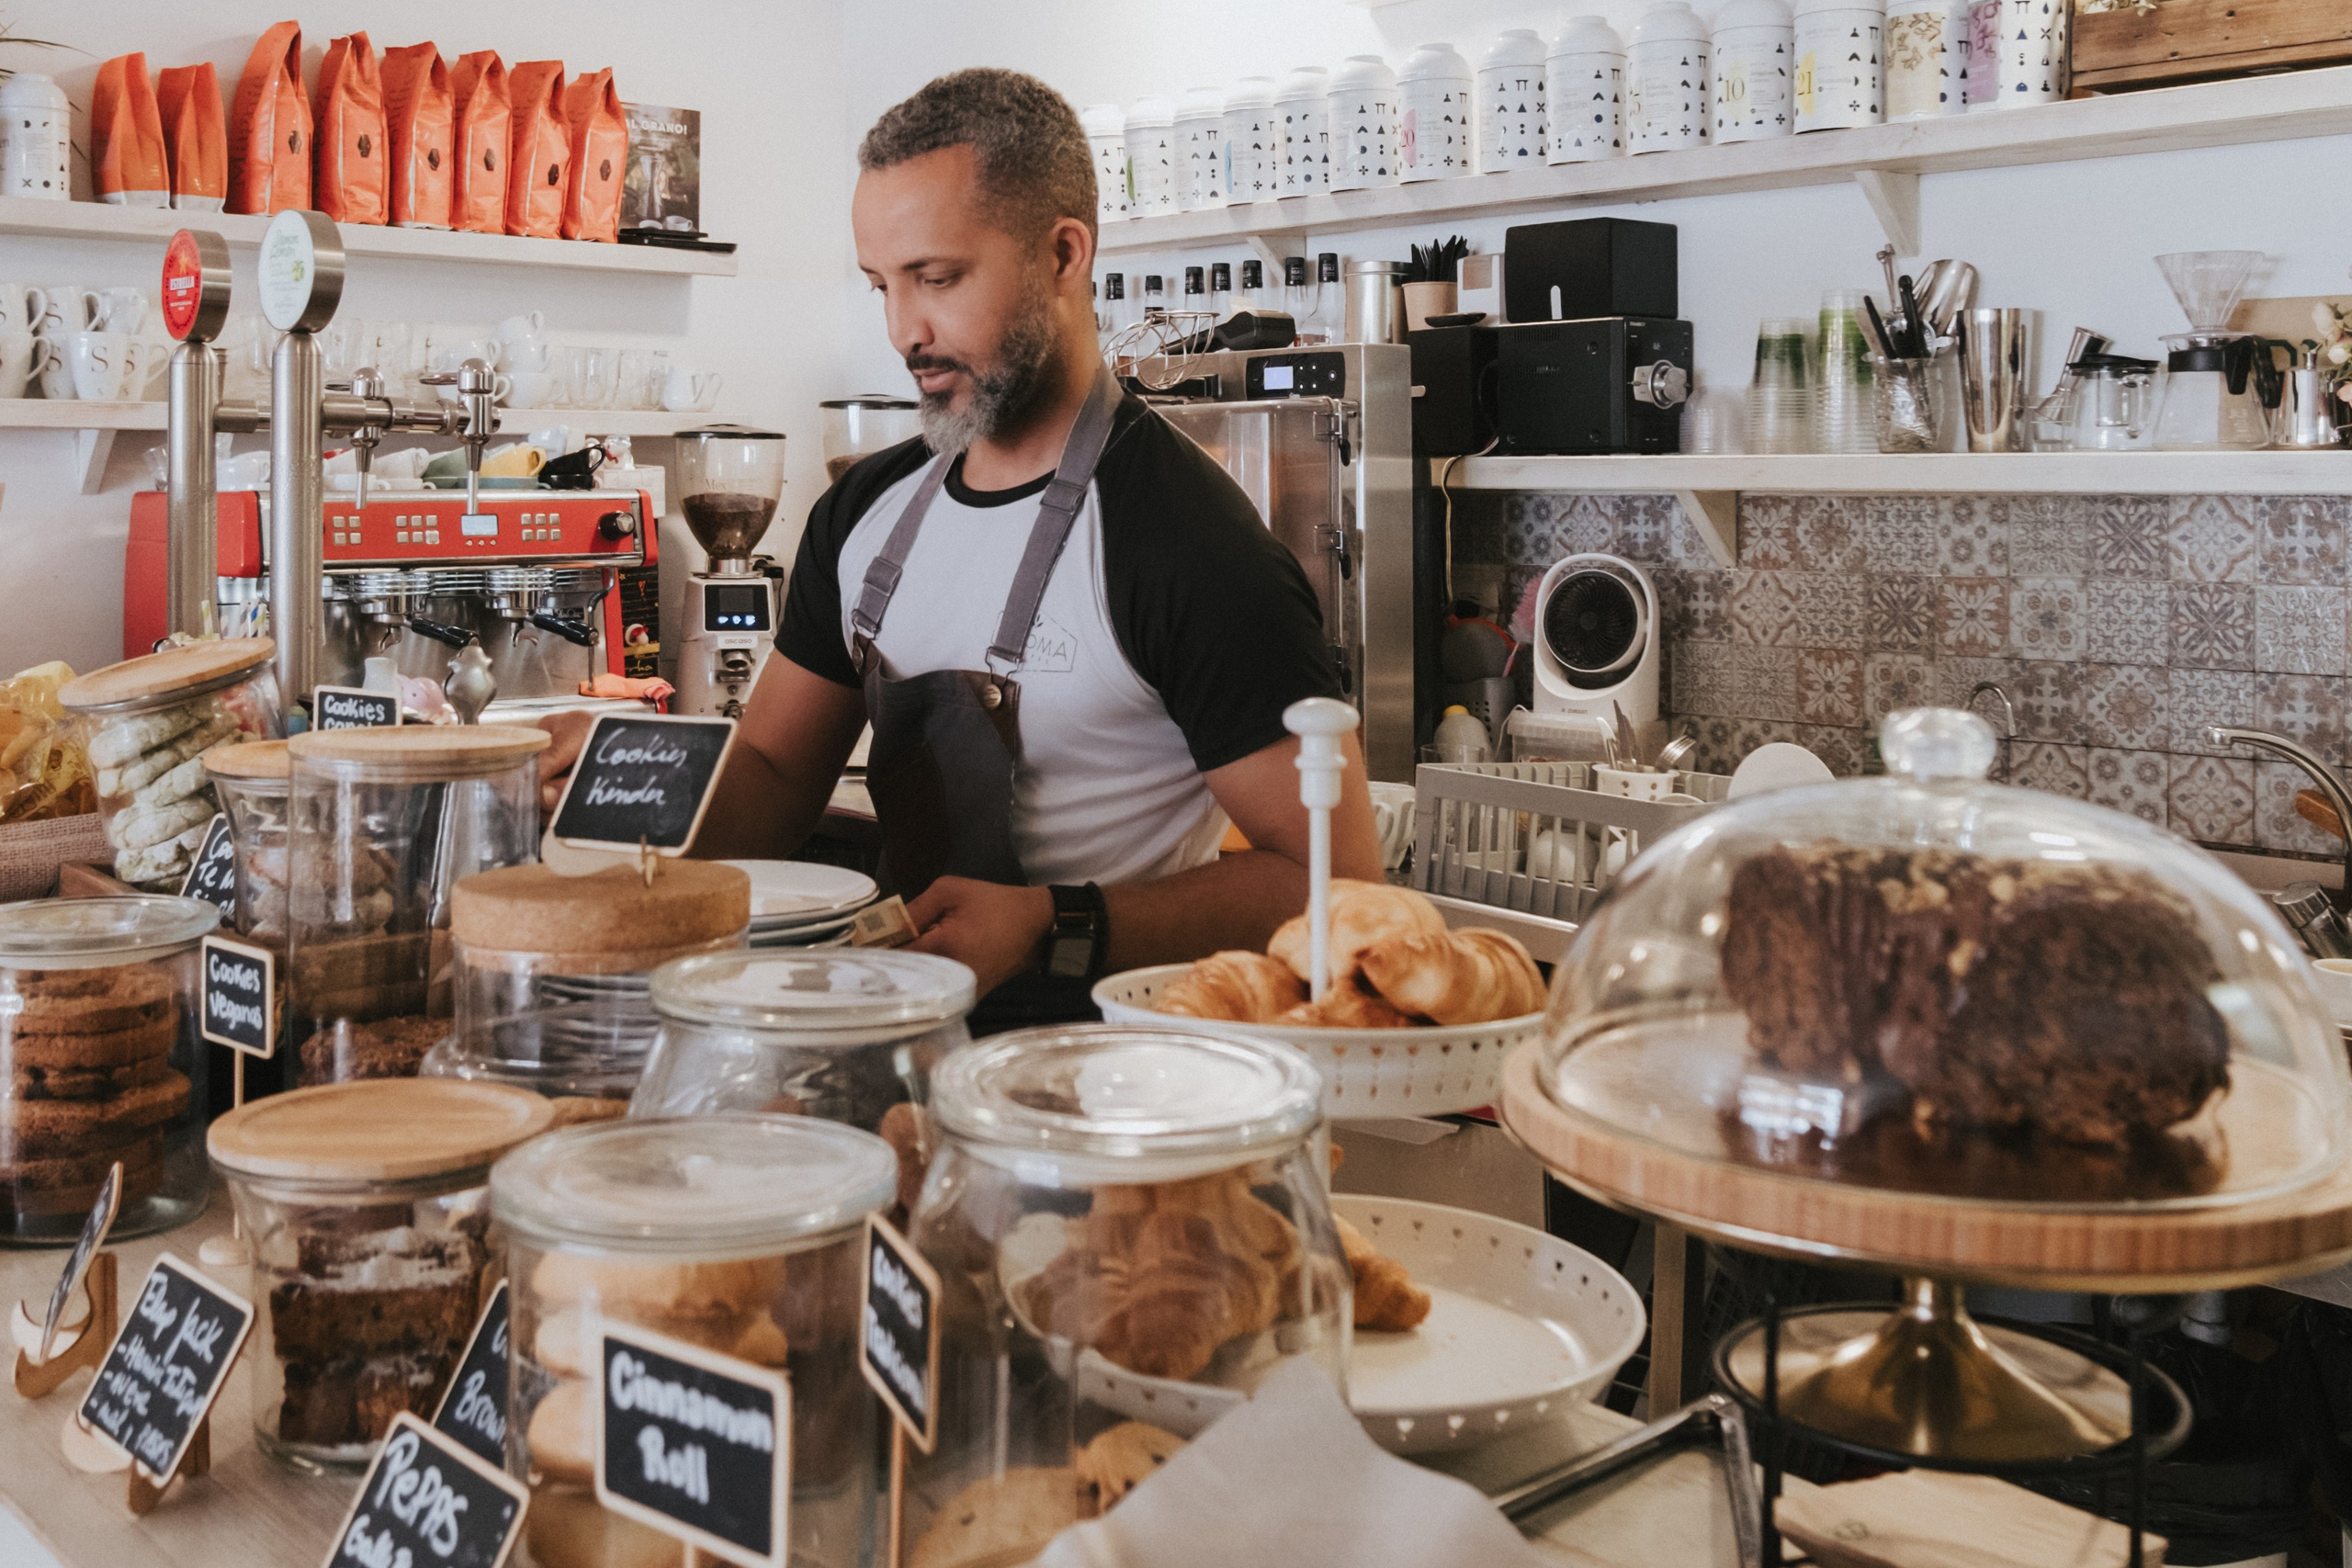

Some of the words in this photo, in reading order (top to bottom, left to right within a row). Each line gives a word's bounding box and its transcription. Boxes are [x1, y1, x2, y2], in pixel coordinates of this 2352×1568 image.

[1724, 77, 1745, 102] 10
[642, 119, 687, 135] GRANO!
[1400, 129, 1415, 148] 20
[92, 345, 109, 374] S
[1026, 634, 1068, 661] OMA
[323, 694, 386, 722] Cookies
[585, 775, 667, 807] Kinder
[209, 953, 261, 994] Cookies
[609, 1349, 775, 1454] Cinnamon
[637, 1424, 710, 1506] Roll
